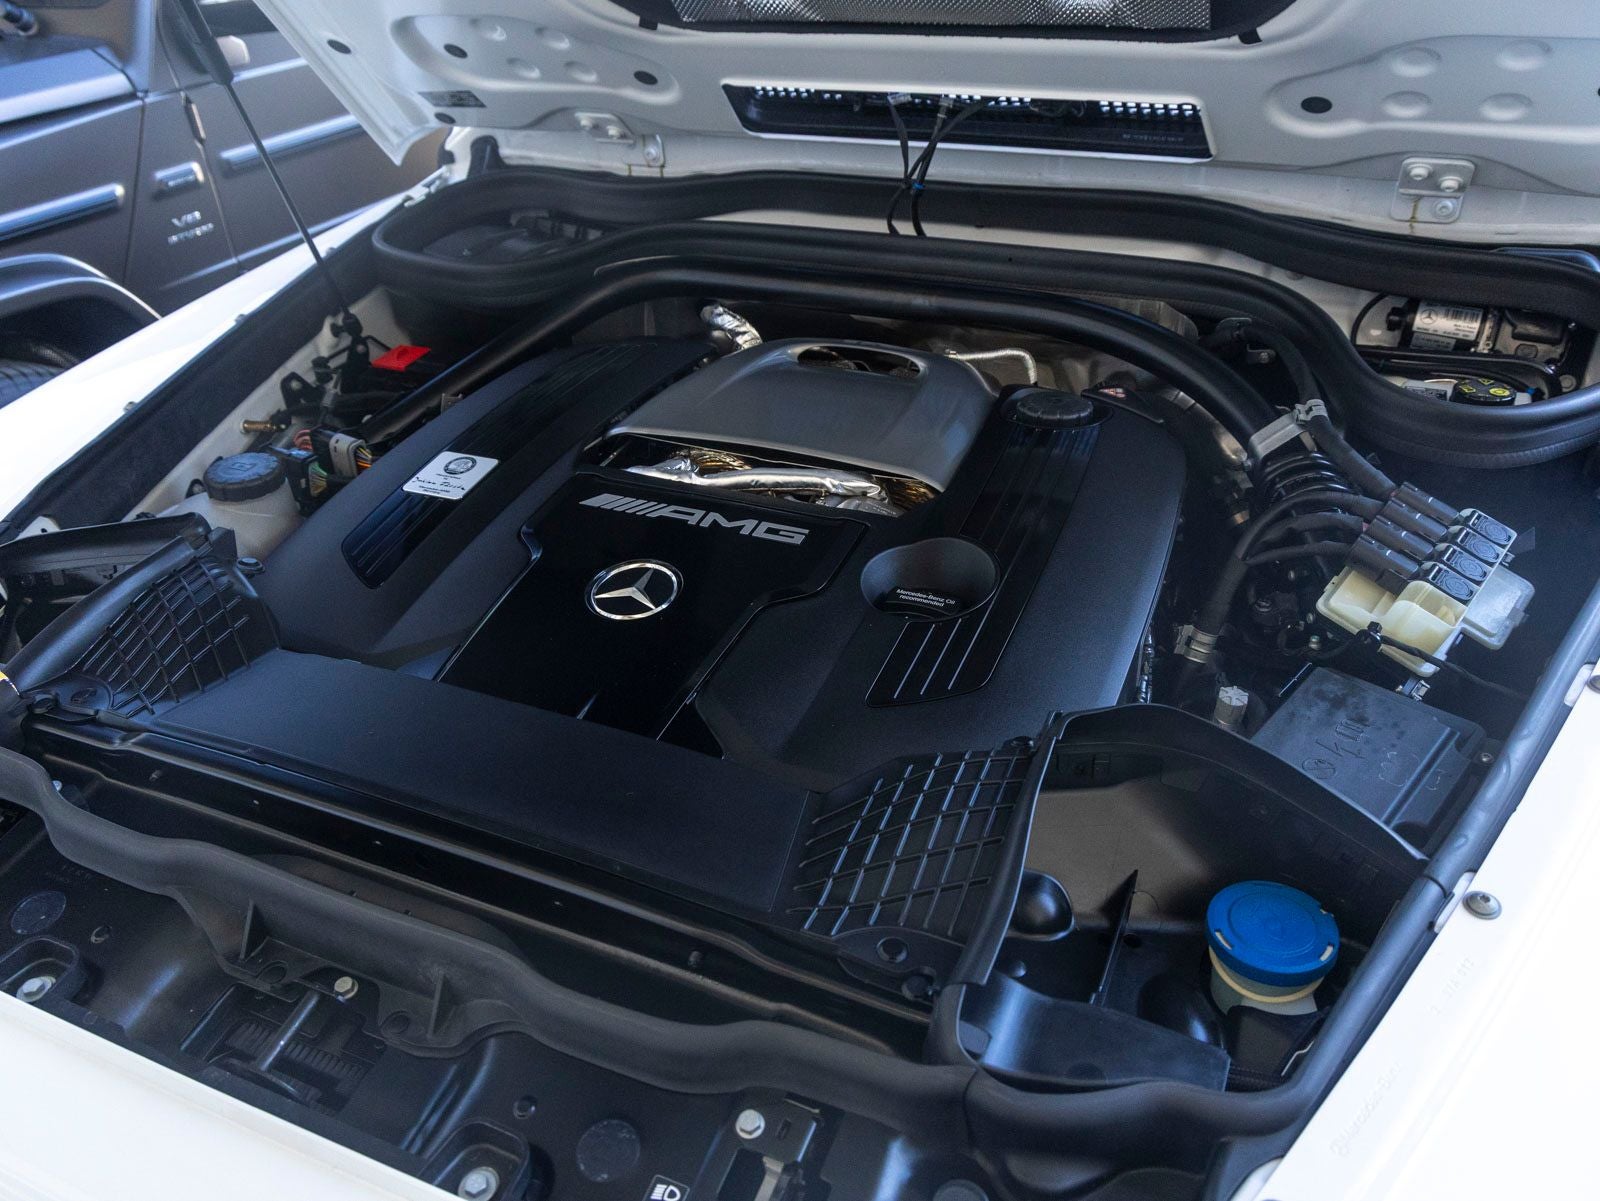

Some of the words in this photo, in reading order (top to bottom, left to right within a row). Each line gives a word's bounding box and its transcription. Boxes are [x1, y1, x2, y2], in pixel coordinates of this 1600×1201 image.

[646, 504, 810, 545] AMG
[896, 588, 945, 603] Mercedes-Benz
[899, 594, 945, 607] recommended
